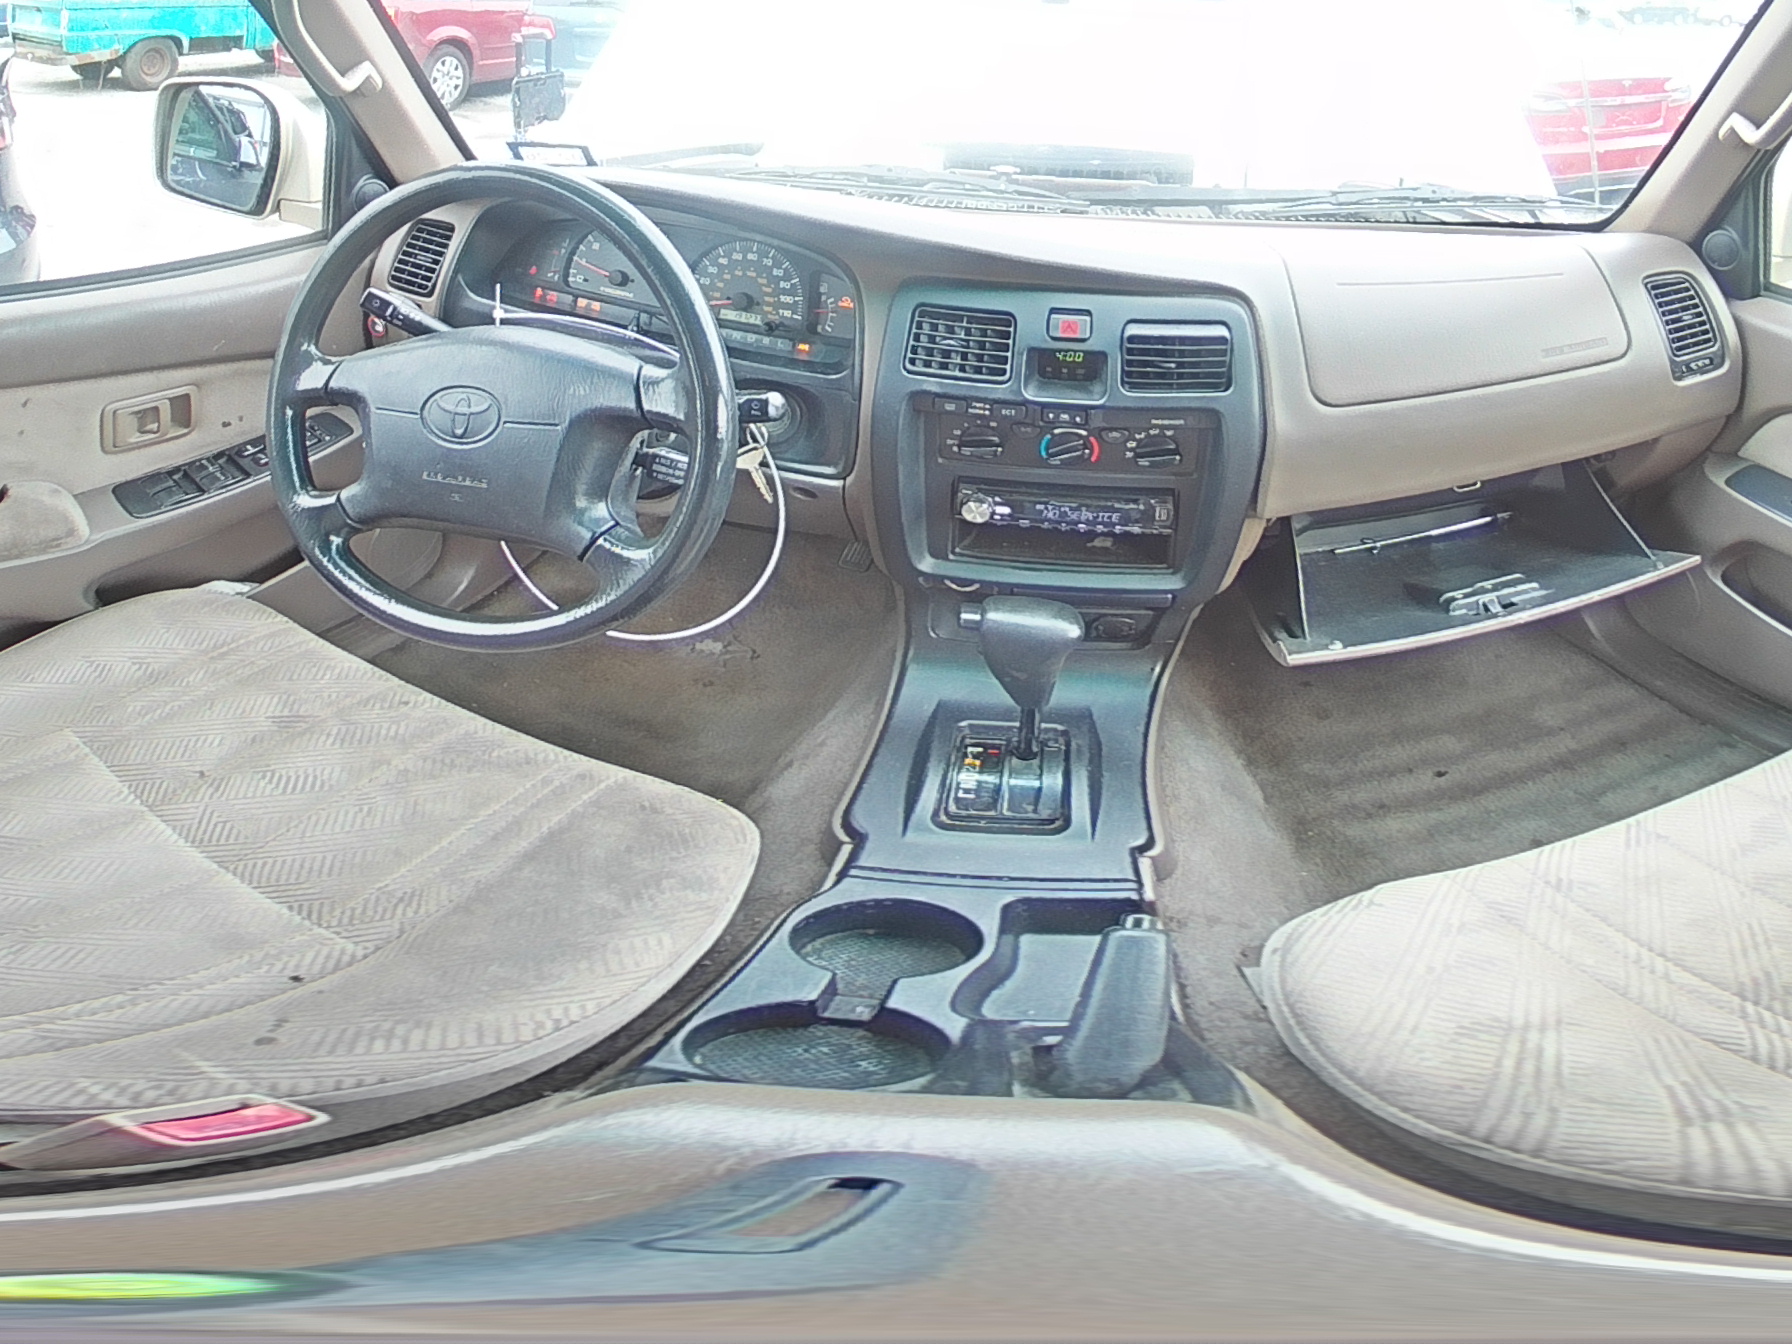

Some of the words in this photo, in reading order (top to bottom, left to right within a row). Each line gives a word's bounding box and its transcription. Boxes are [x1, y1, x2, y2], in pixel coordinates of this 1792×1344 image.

[762, 258, 773, 266] 70
[779, 295, 794, 304] 100
[778, 309, 792, 318] 110
[1055, 351, 1084, 362] 4:00
